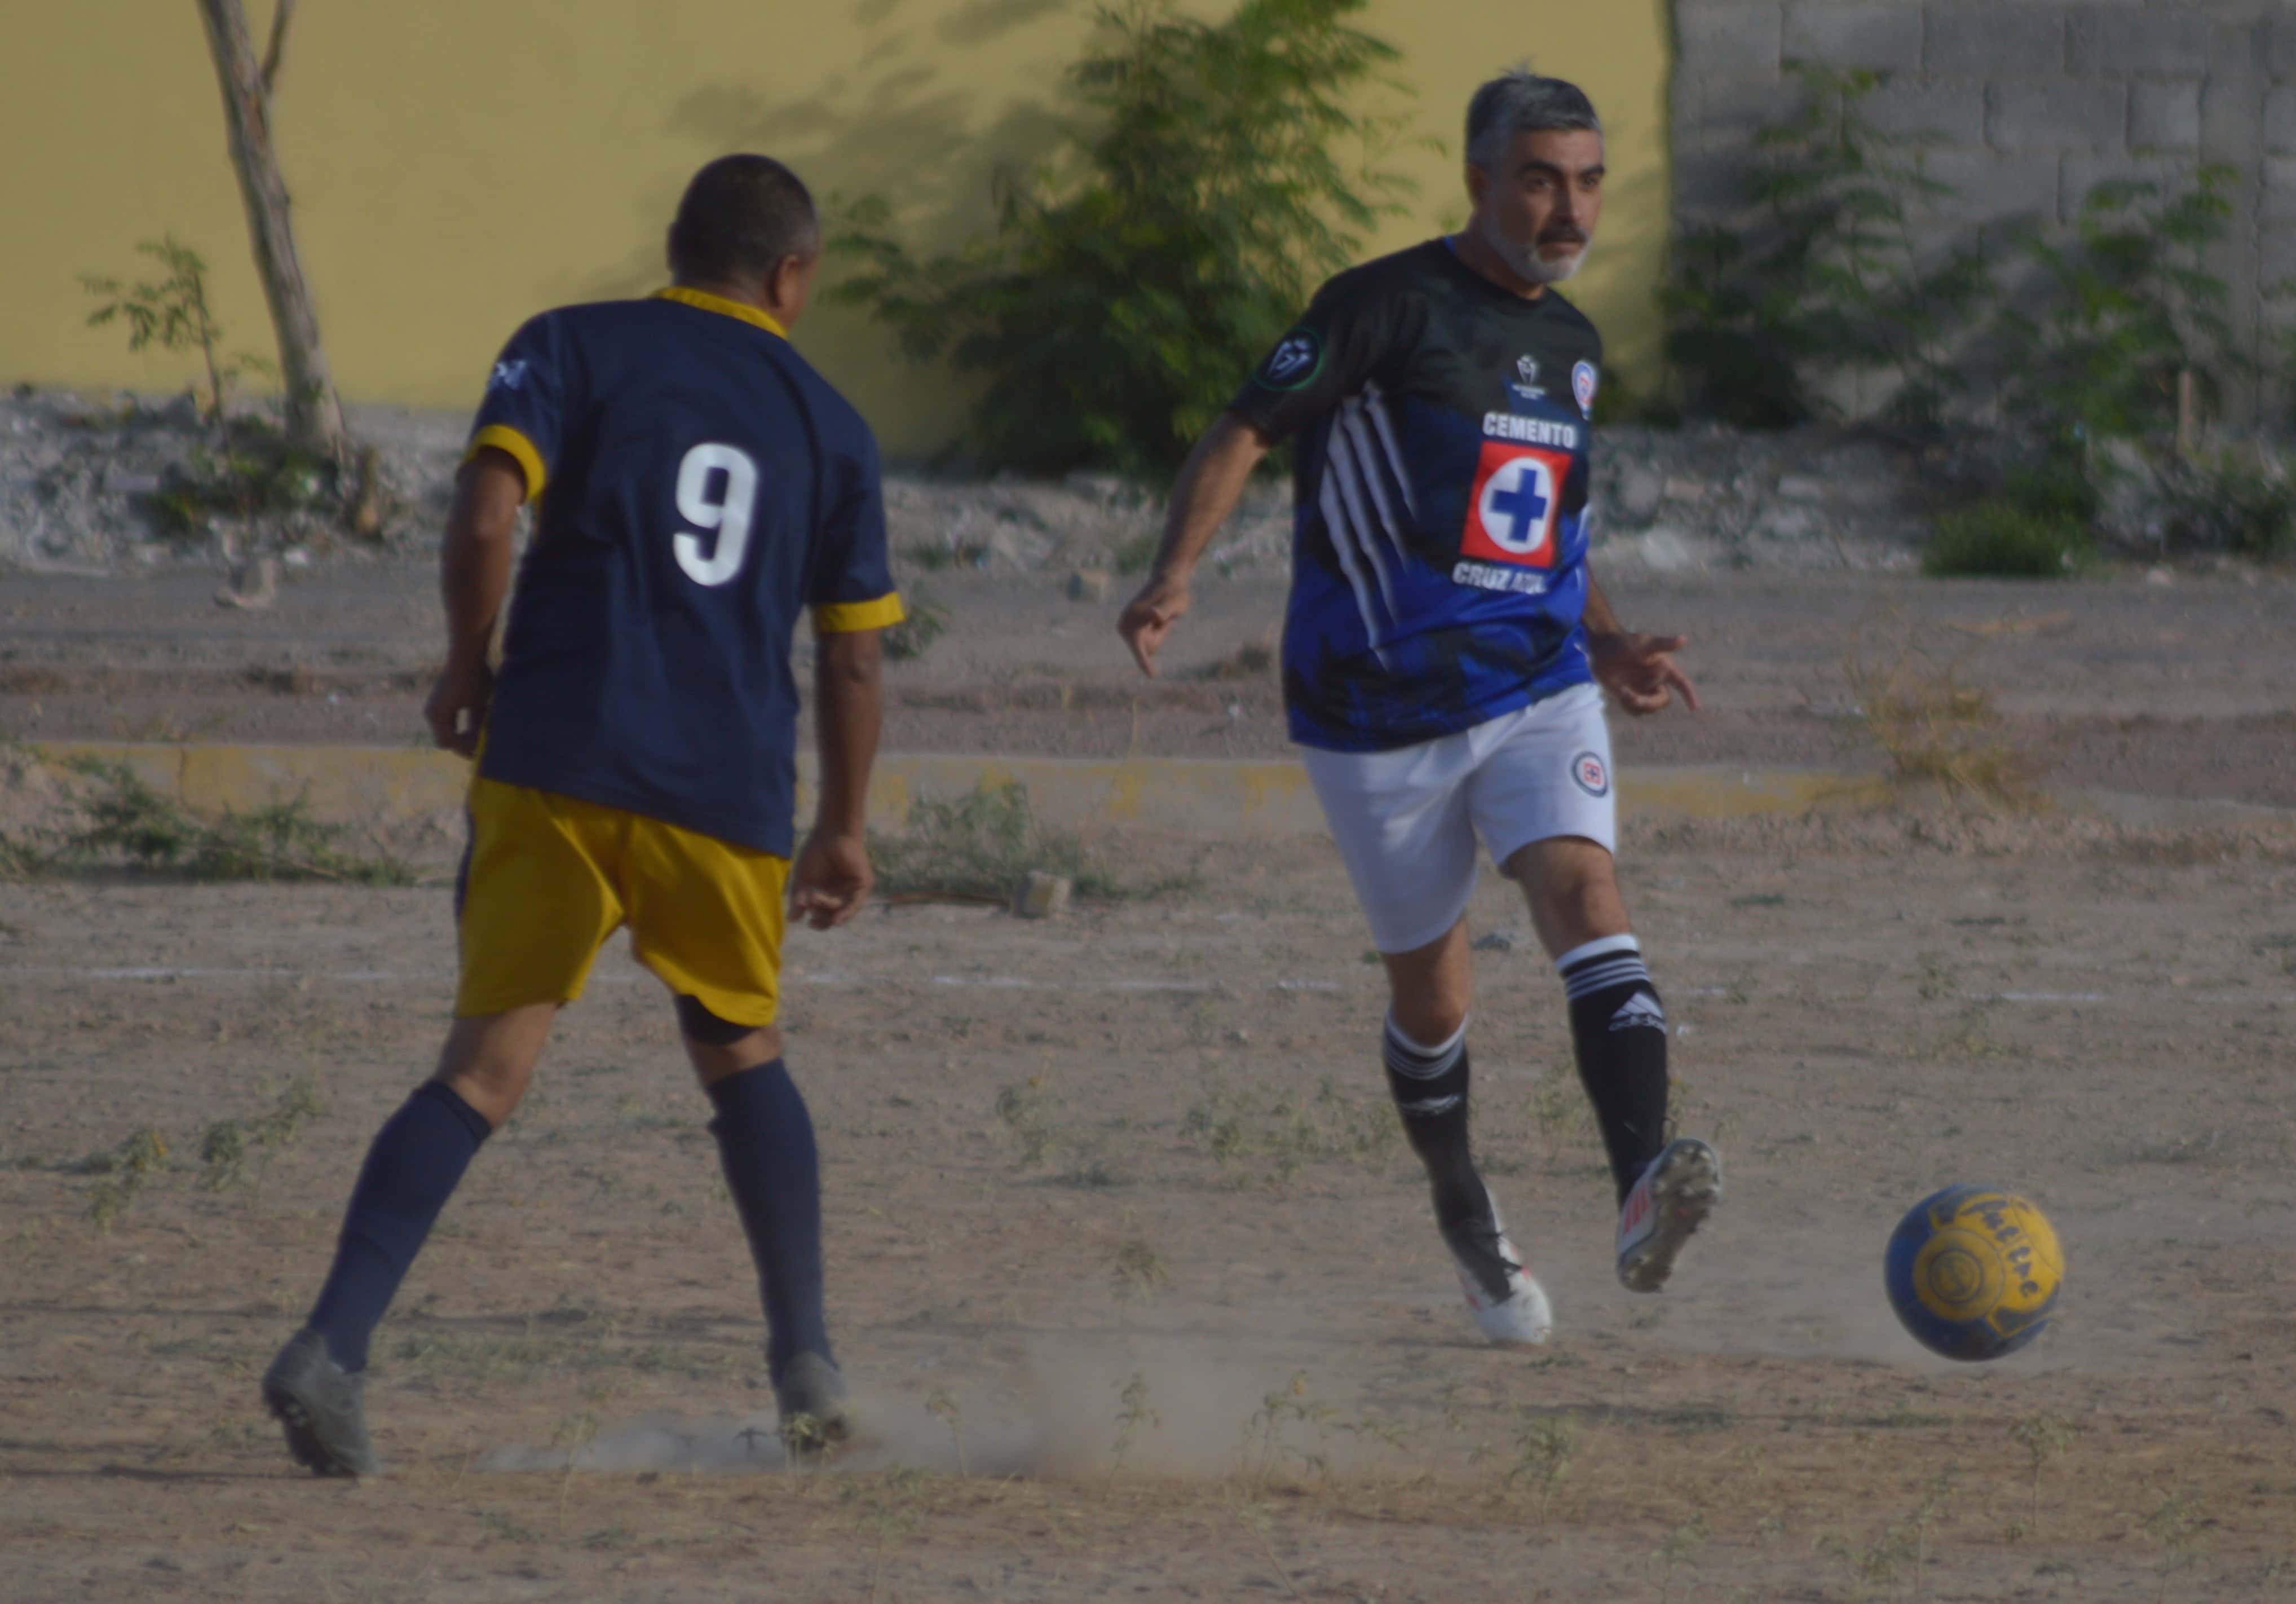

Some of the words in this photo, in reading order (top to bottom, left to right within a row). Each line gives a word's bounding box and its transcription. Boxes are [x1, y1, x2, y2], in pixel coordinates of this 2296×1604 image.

[1483, 412, 1576, 449] CEMENTO
[673, 442, 758, 587] 9
[1452, 562, 1512, 591] CRUZ
